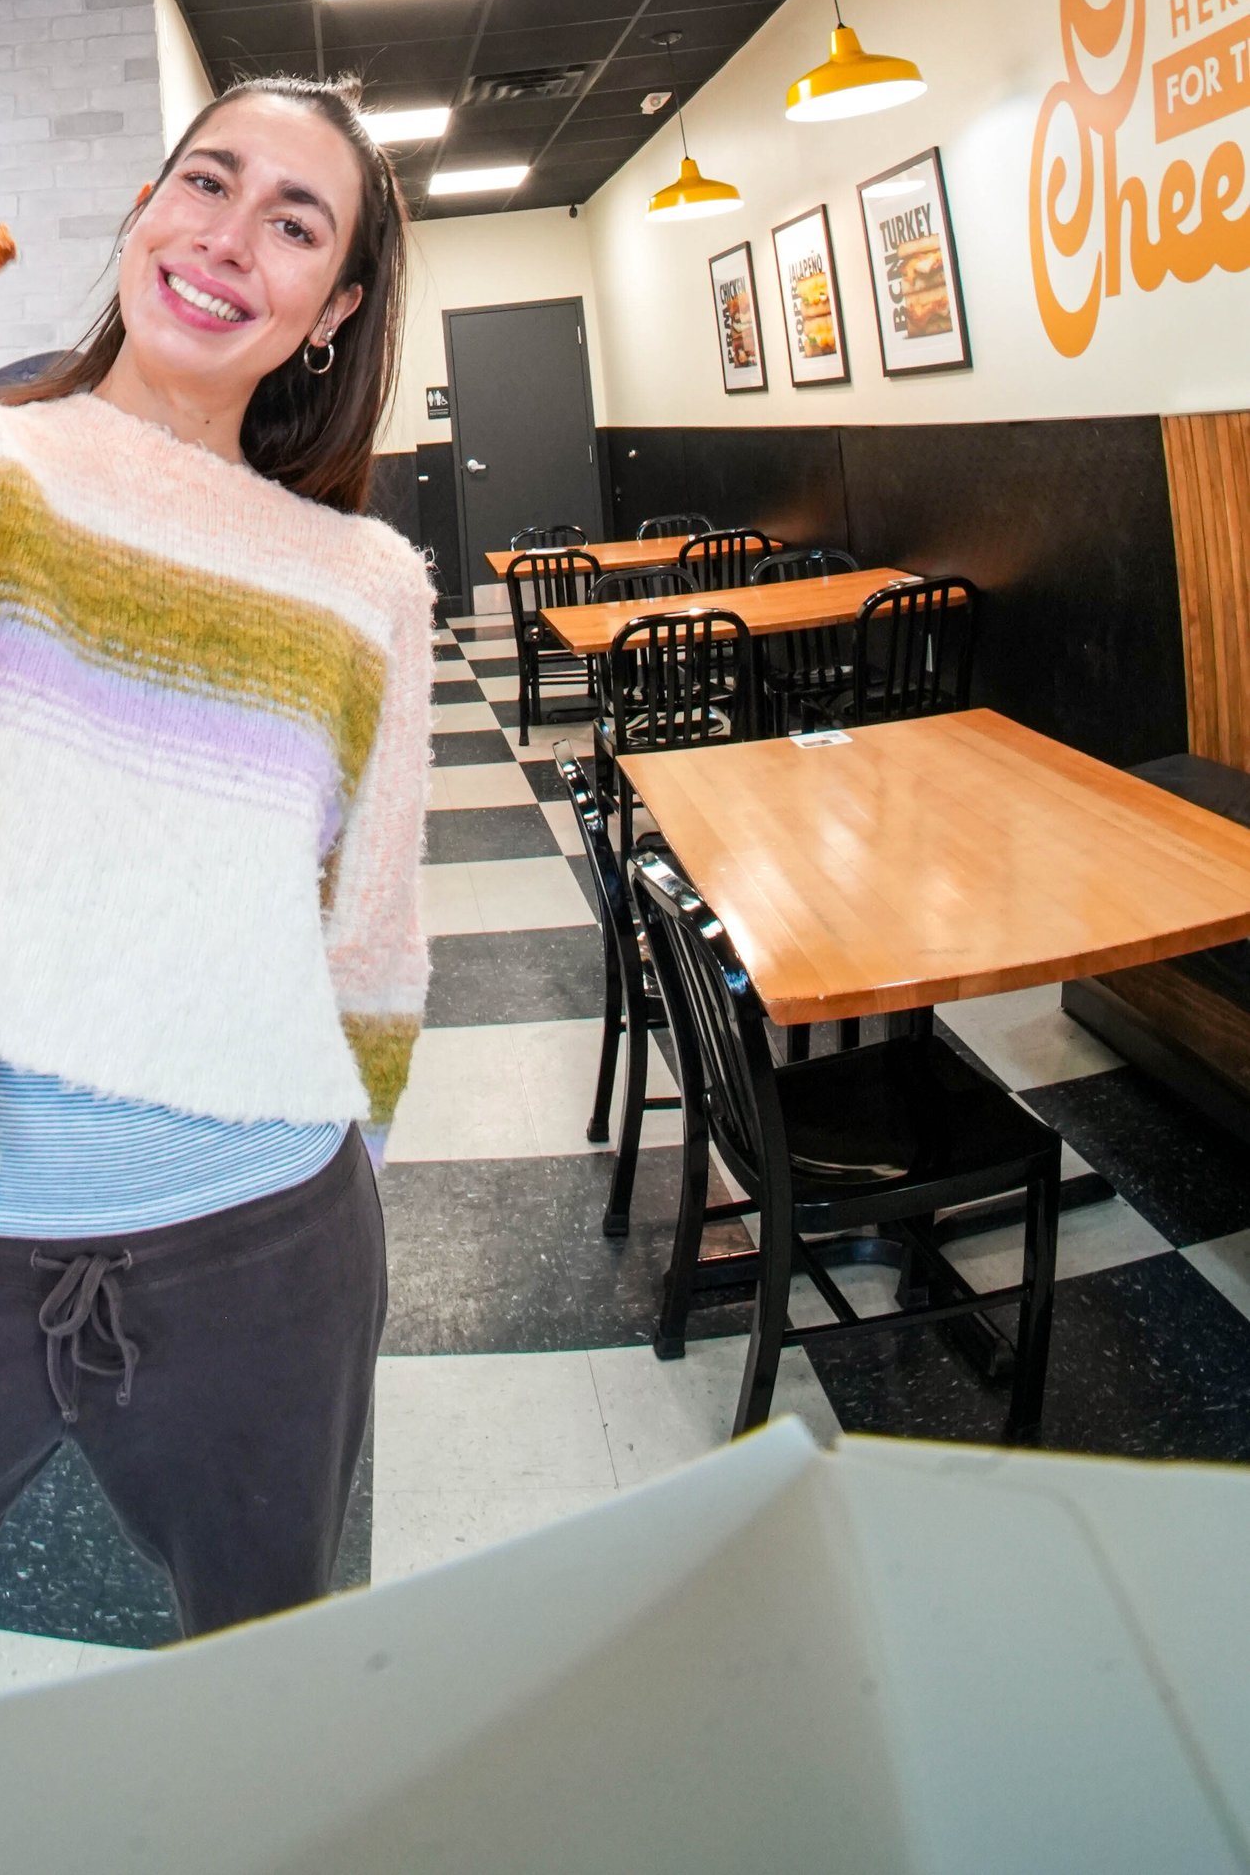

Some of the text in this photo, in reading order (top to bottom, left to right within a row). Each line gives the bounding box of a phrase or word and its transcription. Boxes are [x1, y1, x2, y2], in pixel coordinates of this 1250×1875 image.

[1165, 56, 1221, 114] FOR
[879, 202, 932, 252] TURKEY
[788, 249, 823, 285] JALAPEÑO
[719, 276, 747, 305] CHICKEN
